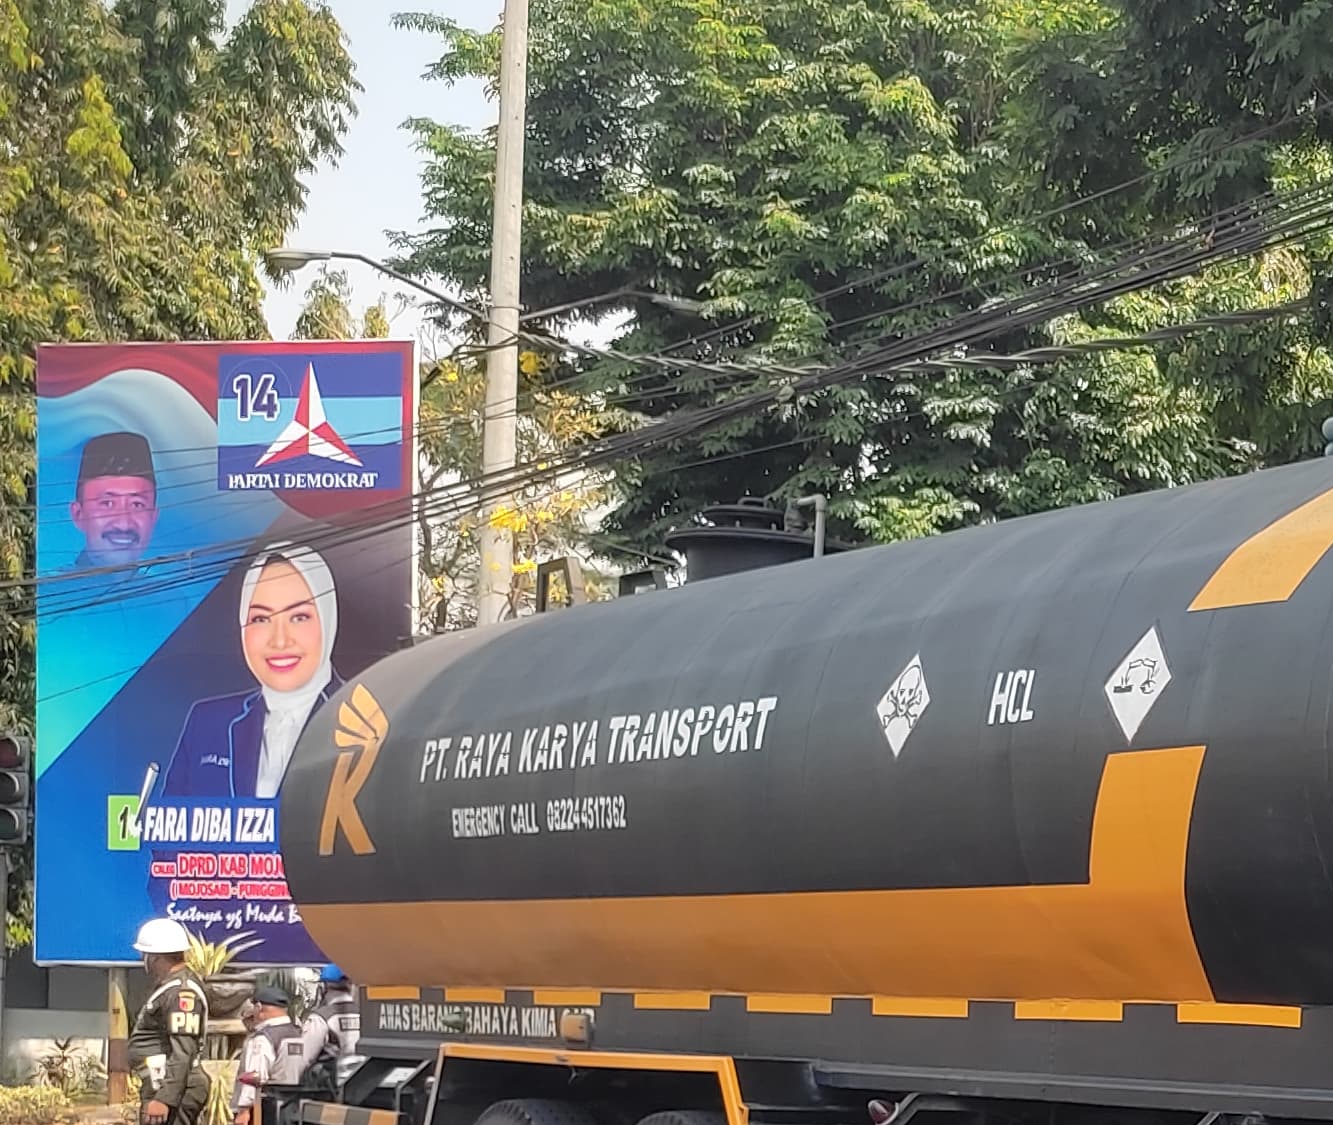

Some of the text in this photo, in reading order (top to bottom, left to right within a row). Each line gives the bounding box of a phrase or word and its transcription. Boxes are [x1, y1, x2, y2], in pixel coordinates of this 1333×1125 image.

[233, 374, 280, 421] 14
[229, 472, 379, 489] PARTAI DEMOKRAT
[987, 669, 1036, 725] HCL
[420, 696, 778, 783] PT. RAYA KARYA TRANSPORT
[144, 807, 187, 842] FARA
[191, 807, 232, 842] DIBA
[235, 807, 275, 842] IZZA
[452, 803, 505, 838] EMERGENCY
[510, 802, 539, 834] CALL
[178, 854, 217, 877] DPRD
[218, 854, 248, 877] KAB
[249, 854, 285, 878] MOJ
[167, 902, 223, 928] Saatnya
[226, 908, 242, 929] yg
[246, 903, 285, 922] Muda
[171, 1011, 200, 1034] PM
[379, 1002, 411, 1031] AWAS
[463, 1005, 518, 1036] BAHAYA
[521, 1007, 557, 1037] KIMIA
